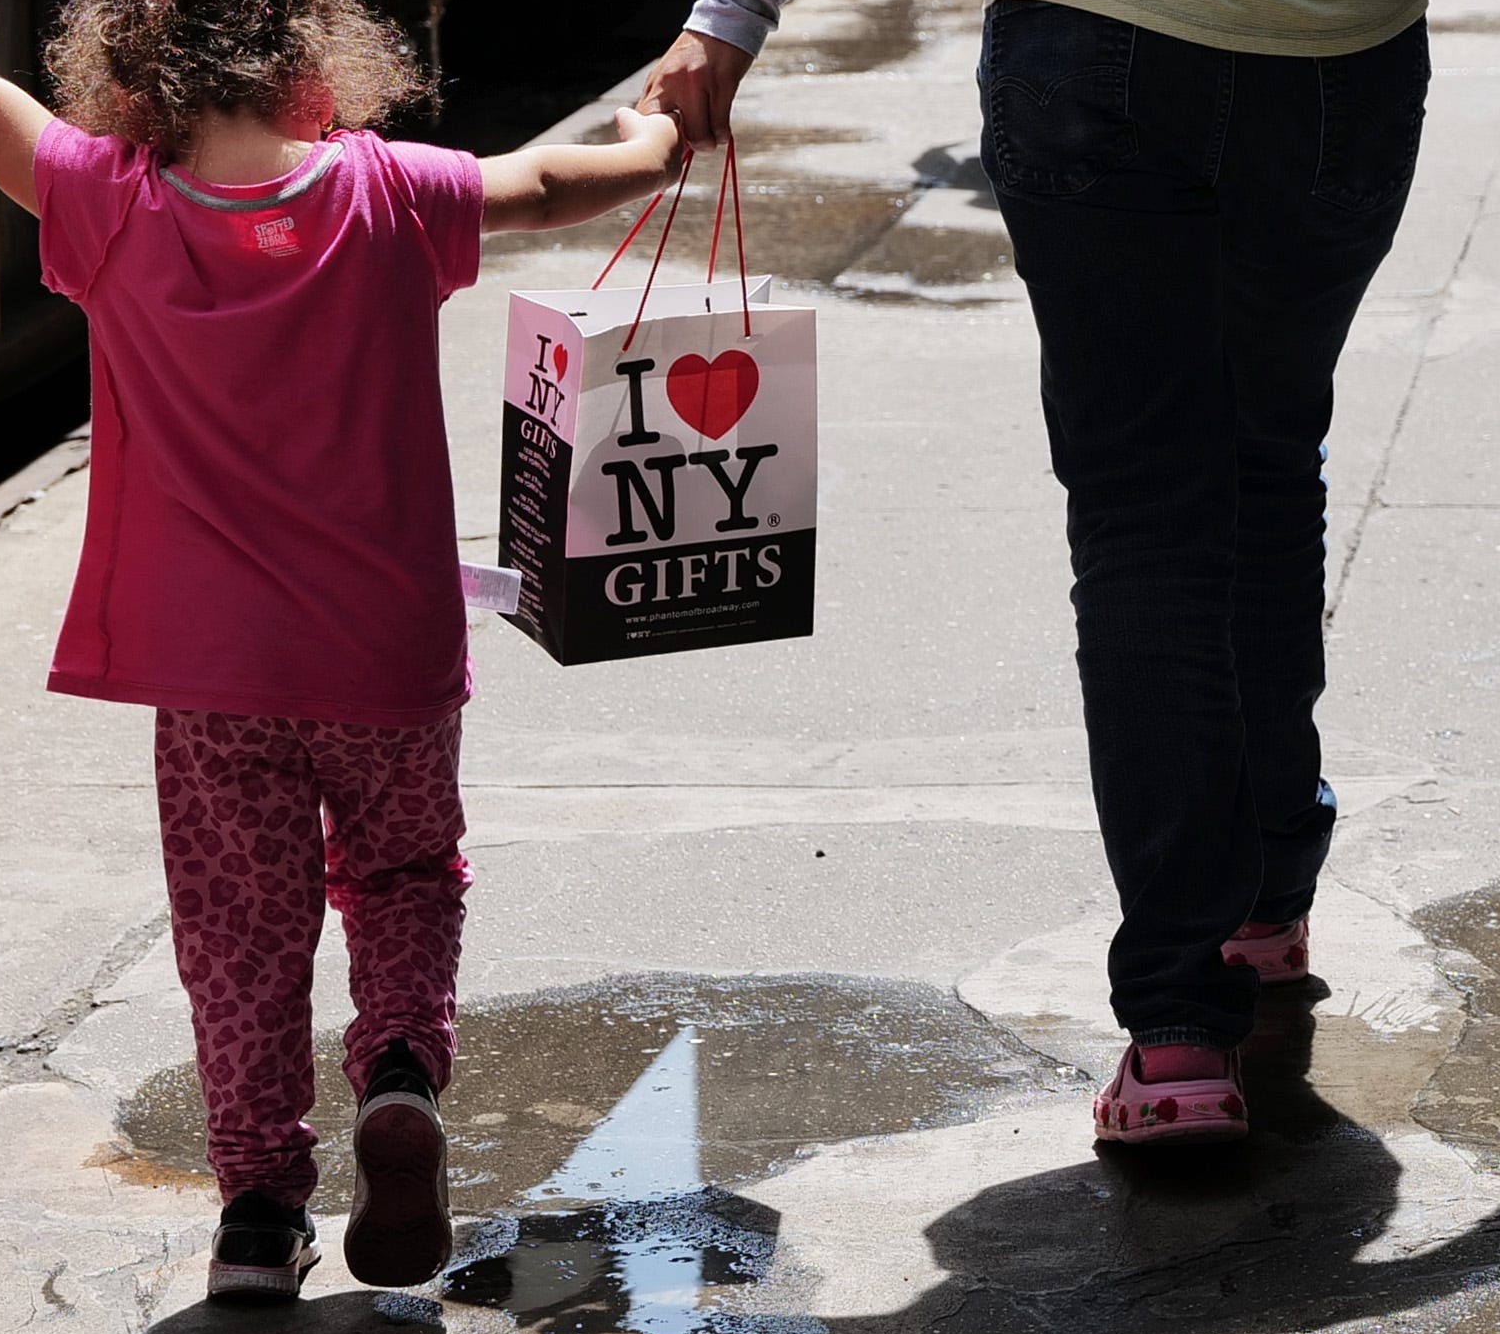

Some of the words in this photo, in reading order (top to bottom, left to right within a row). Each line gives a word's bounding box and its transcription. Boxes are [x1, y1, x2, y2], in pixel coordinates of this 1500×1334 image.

[254, 216, 294, 237] SPOTTED
[256, 233, 288, 248] ZEBRA
[534, 334, 551, 373] I
[525, 371, 565, 426] NY
[616, 358, 660, 447] I
[520, 419, 558, 460] GIFTS
[601, 444, 778, 546] NY
[604, 544, 782, 606] GIFTS
[625, 600, 760, 625] www.phantomofbroadway.com
